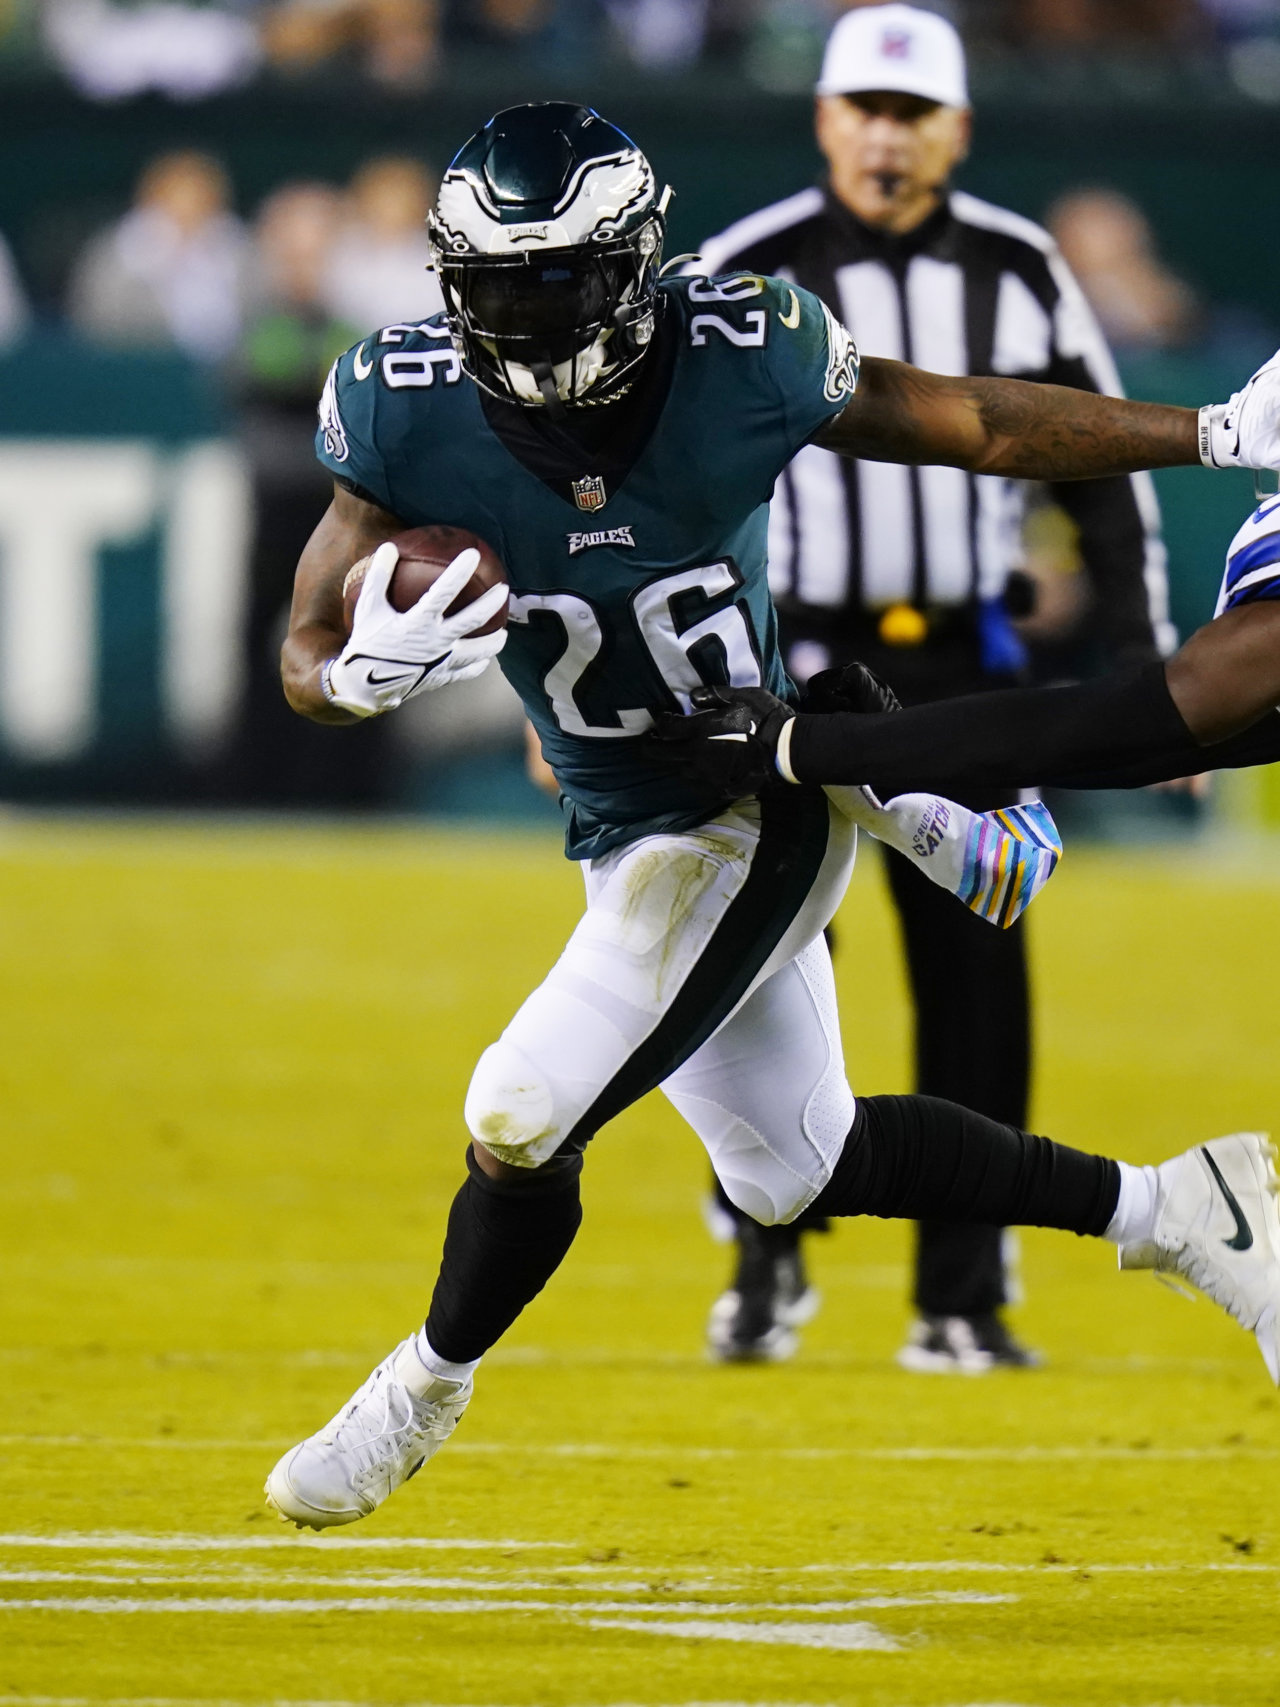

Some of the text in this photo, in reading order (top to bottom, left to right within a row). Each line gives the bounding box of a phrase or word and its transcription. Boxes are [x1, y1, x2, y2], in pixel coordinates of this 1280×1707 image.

[688, 276, 766, 347] 26
[1200, 426, 1210, 457] BEYOND
[580, 491, 603, 507] NFL
[566, 525, 636, 555] EAGLES
[508, 562, 762, 738] 26
[912, 799, 951, 857] CATCH
